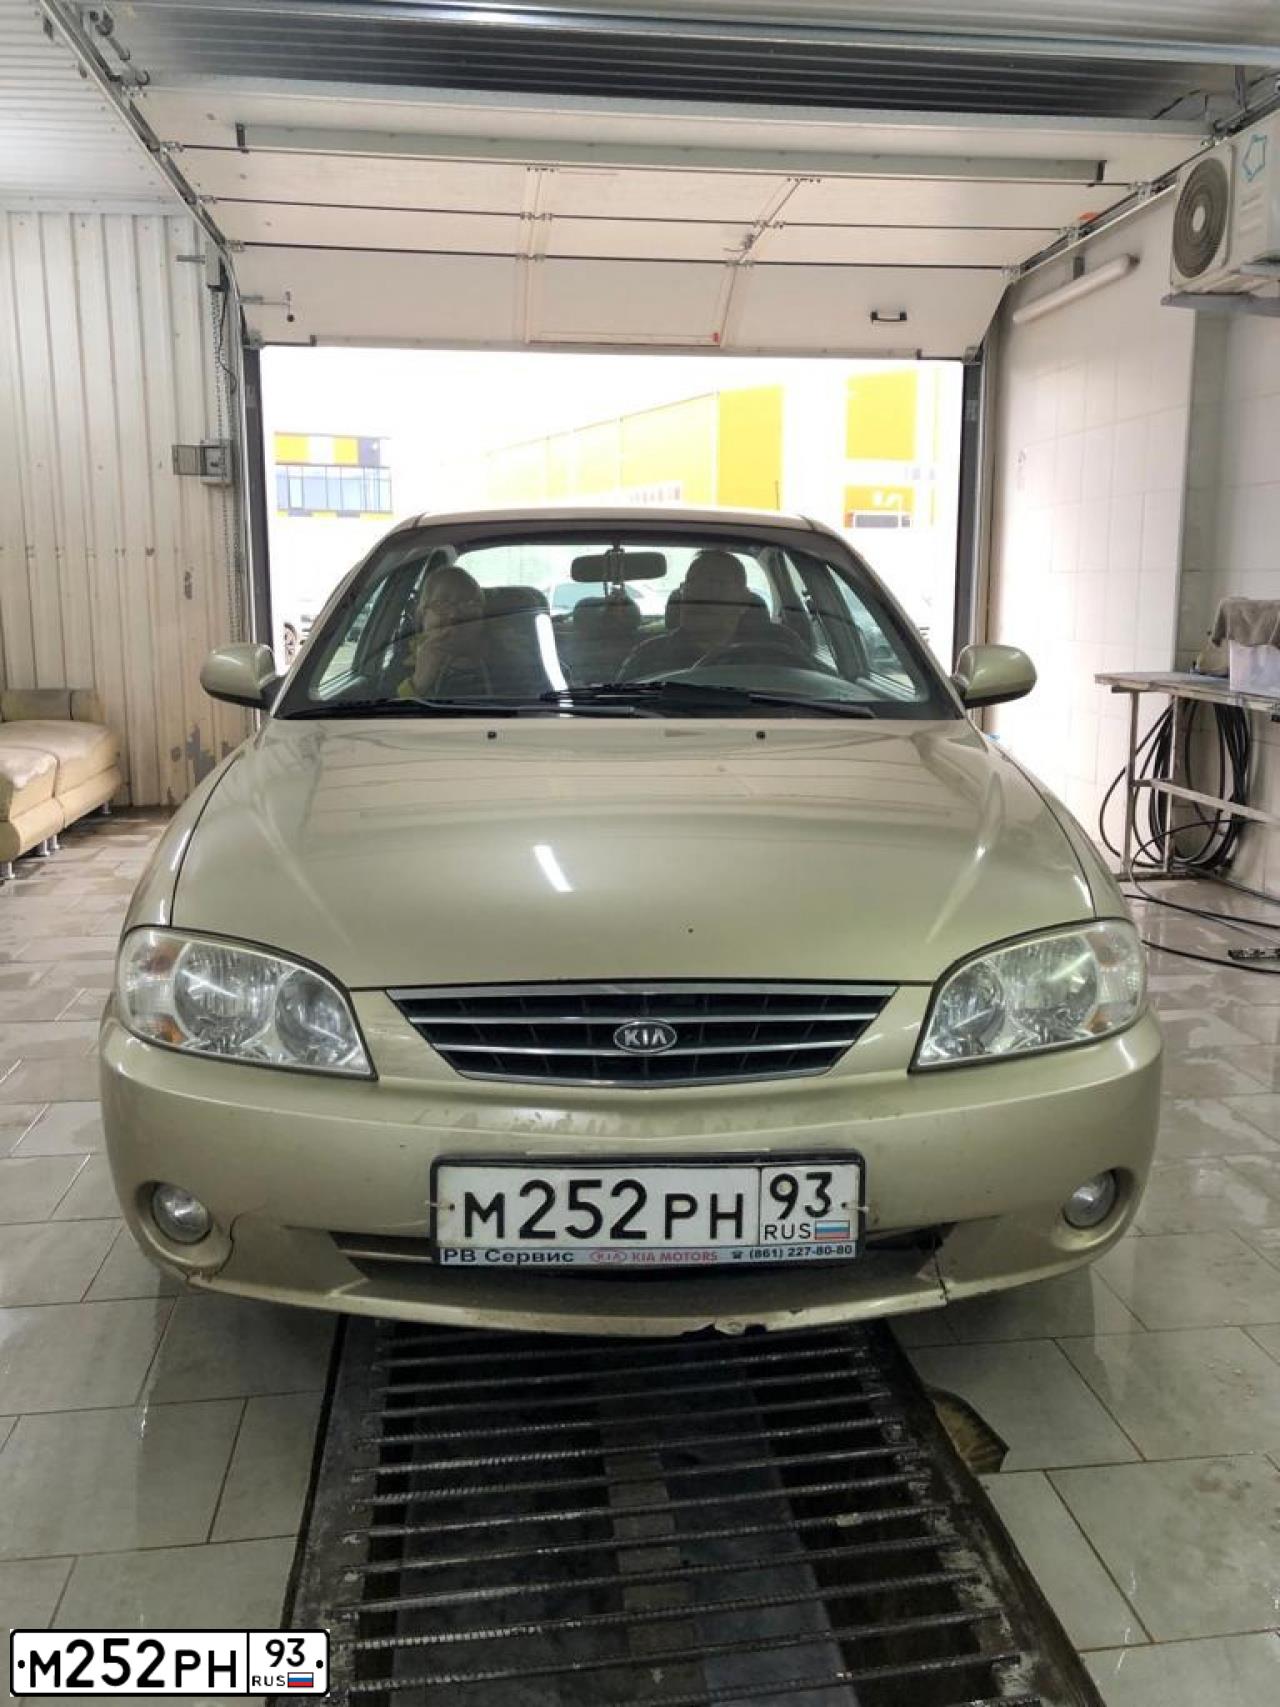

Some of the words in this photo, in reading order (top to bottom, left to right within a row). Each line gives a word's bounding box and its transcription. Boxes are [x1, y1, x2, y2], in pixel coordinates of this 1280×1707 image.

[624, 1029, 667, 1046] KIA
[769, 1172, 832, 1220] 93
[764, 1223, 811, 1240] RUS
[444, 1248, 476, 1263] РВ
[484, 1247, 574, 1265] Сервис
[632, 1251, 656, 1263] KIA
[660, 1250, 718, 1263] MOTORS
[749, 1247, 784, 1260] (861)
[787, 1244, 853, 1258] 227-80-80
